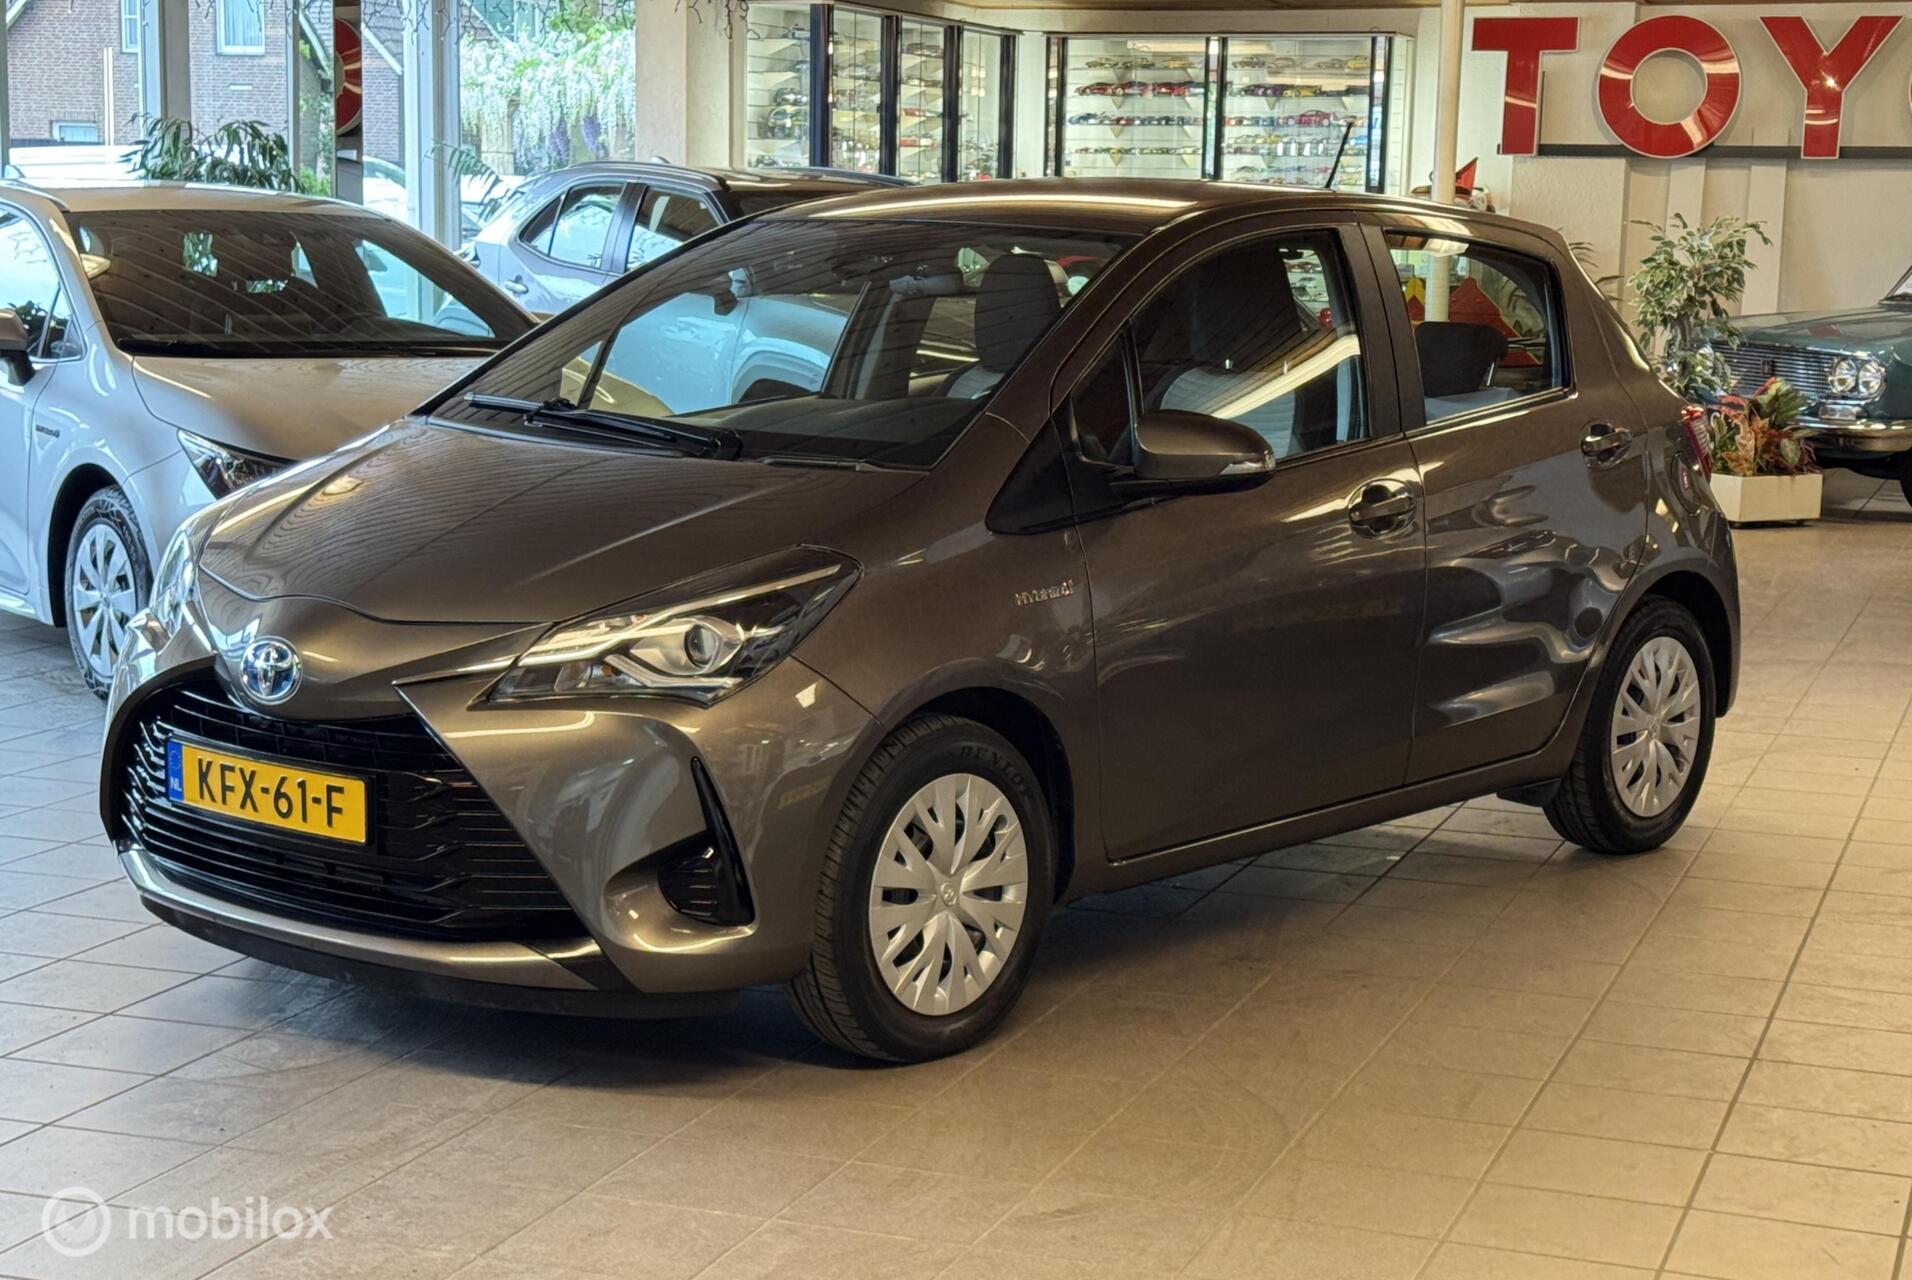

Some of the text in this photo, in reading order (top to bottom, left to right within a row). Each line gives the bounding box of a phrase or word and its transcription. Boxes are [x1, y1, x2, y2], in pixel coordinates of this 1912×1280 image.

[1471, 15, 1912, 159] TOY
[169, 776, 183, 793] NL
[197, 757, 345, 828] KFX-61-F
